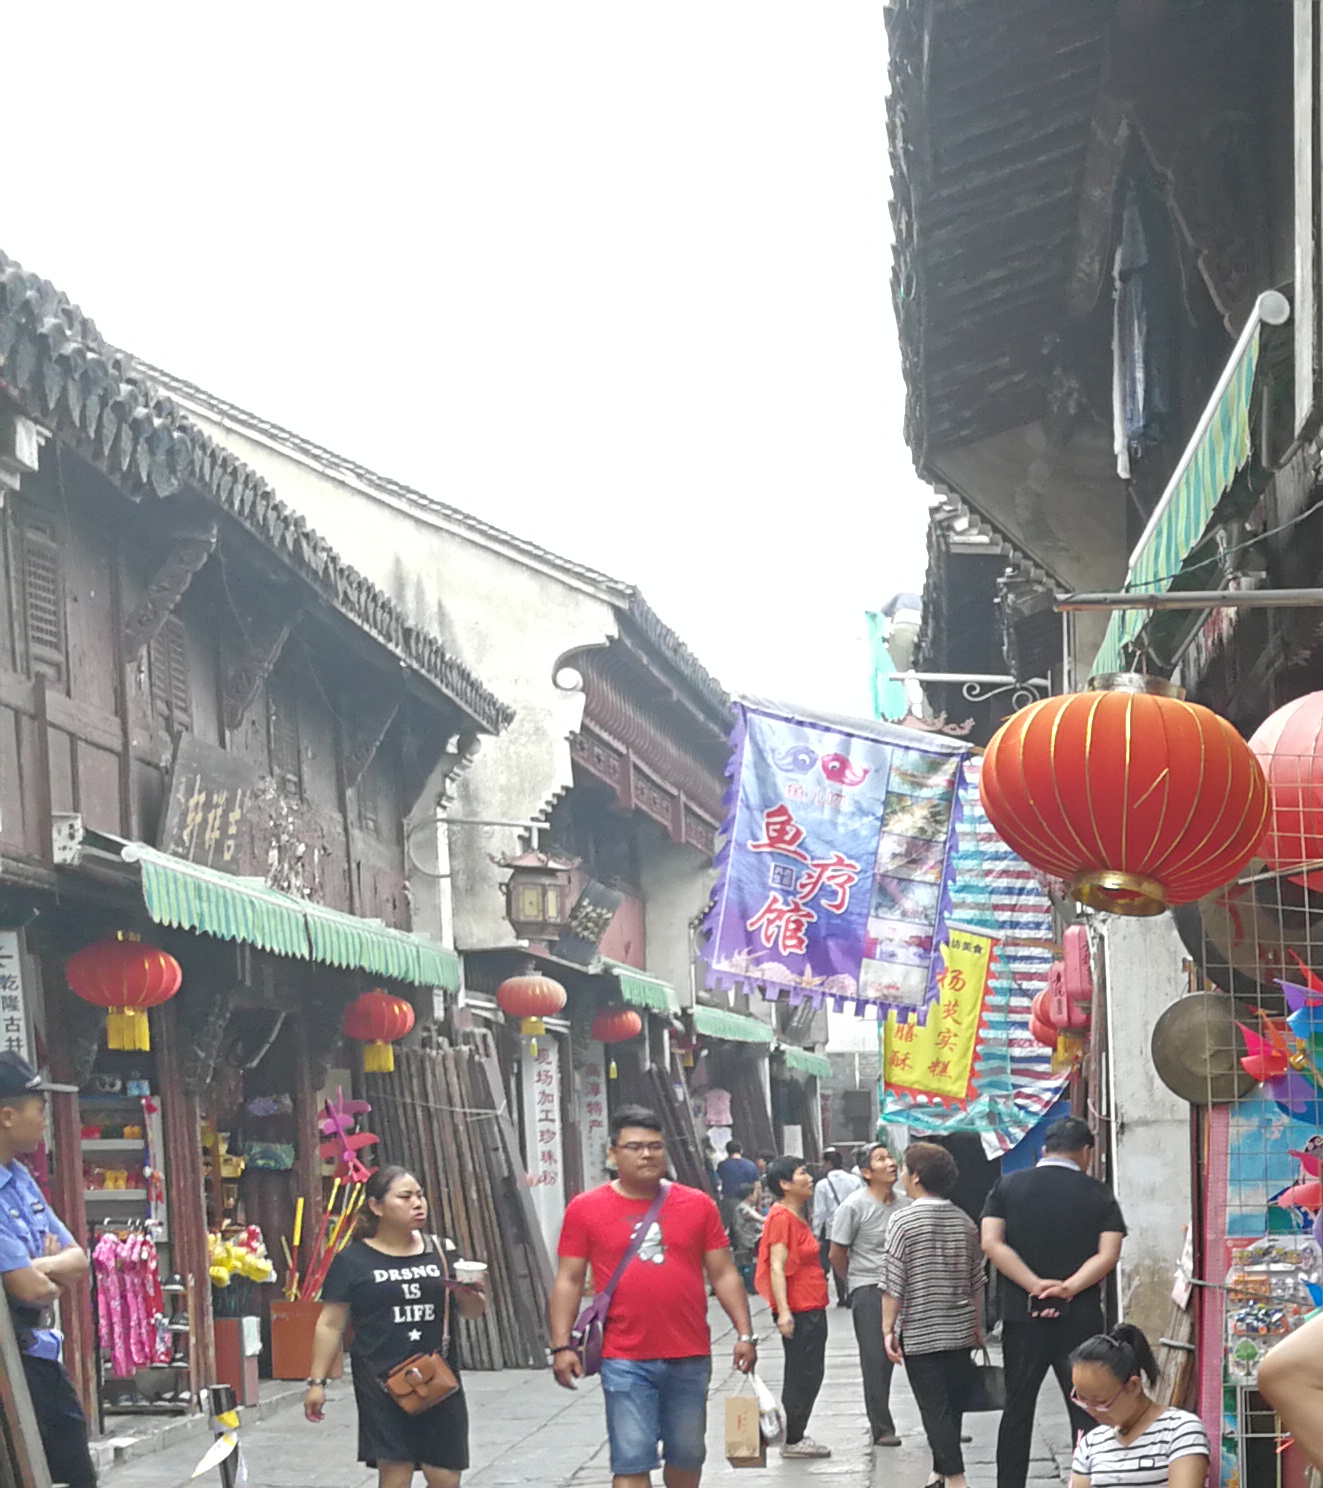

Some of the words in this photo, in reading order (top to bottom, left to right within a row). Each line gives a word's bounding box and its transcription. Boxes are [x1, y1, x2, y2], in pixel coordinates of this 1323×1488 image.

[748, 804, 860, 956] 鱼疗馆
[402, 1283, 421, 1299] IS
[393, 1304, 435, 1323] LIFE
